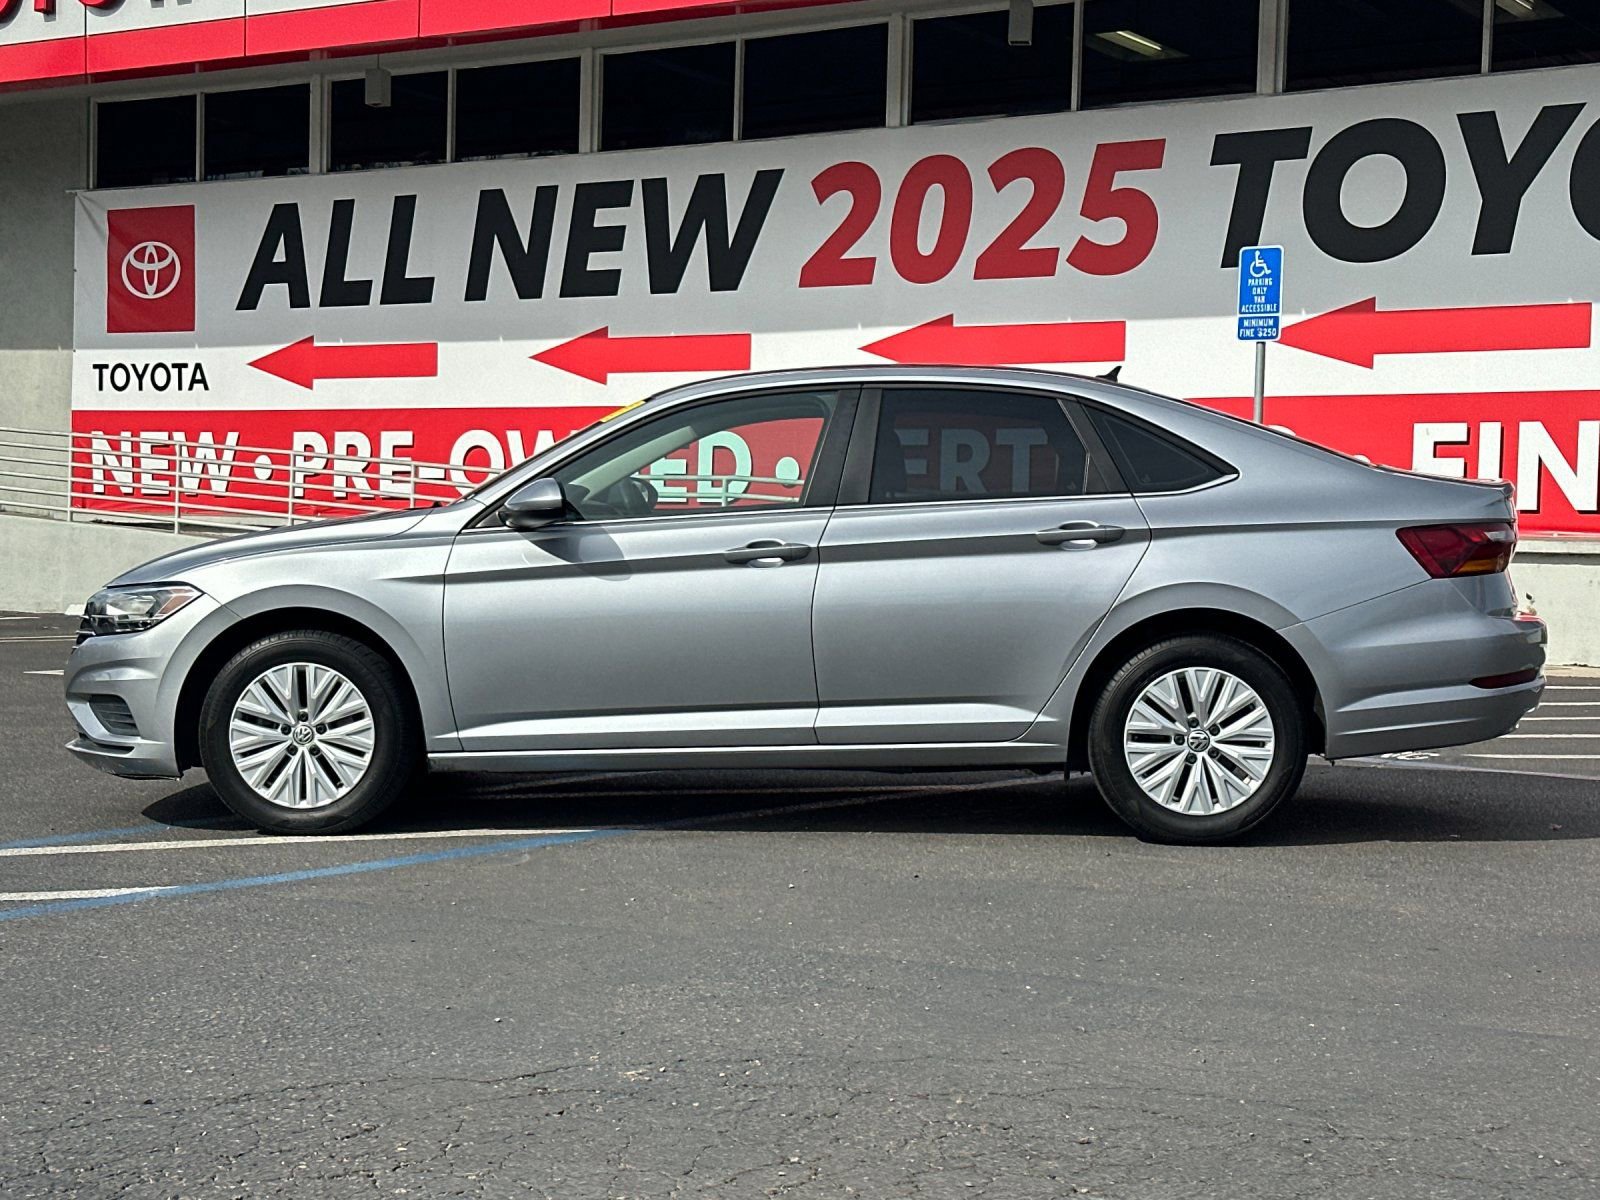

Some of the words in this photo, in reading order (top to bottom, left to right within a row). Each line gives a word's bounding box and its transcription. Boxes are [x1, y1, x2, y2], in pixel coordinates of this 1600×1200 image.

[236, 195, 434, 311] ALL
[465, 168, 785, 301] NEW
[799, 139, 1166, 287] 2025
[1209, 102, 1600, 269] TOY
[1248, 278, 1273, 286] PARKING
[1252, 286, 1268, 295] ONLY
[1241, 303, 1278, 313] ACCESSIBLE
[1243, 318, 1274, 327] MINIMUM
[1239, 328, 1255, 338] FINE
[1257, 327, 1277, 337] $250
[92, 362, 209, 392] TOYOTA
[90, 430, 240, 497] NEW
[292, 428, 752, 503] PRE-OED
